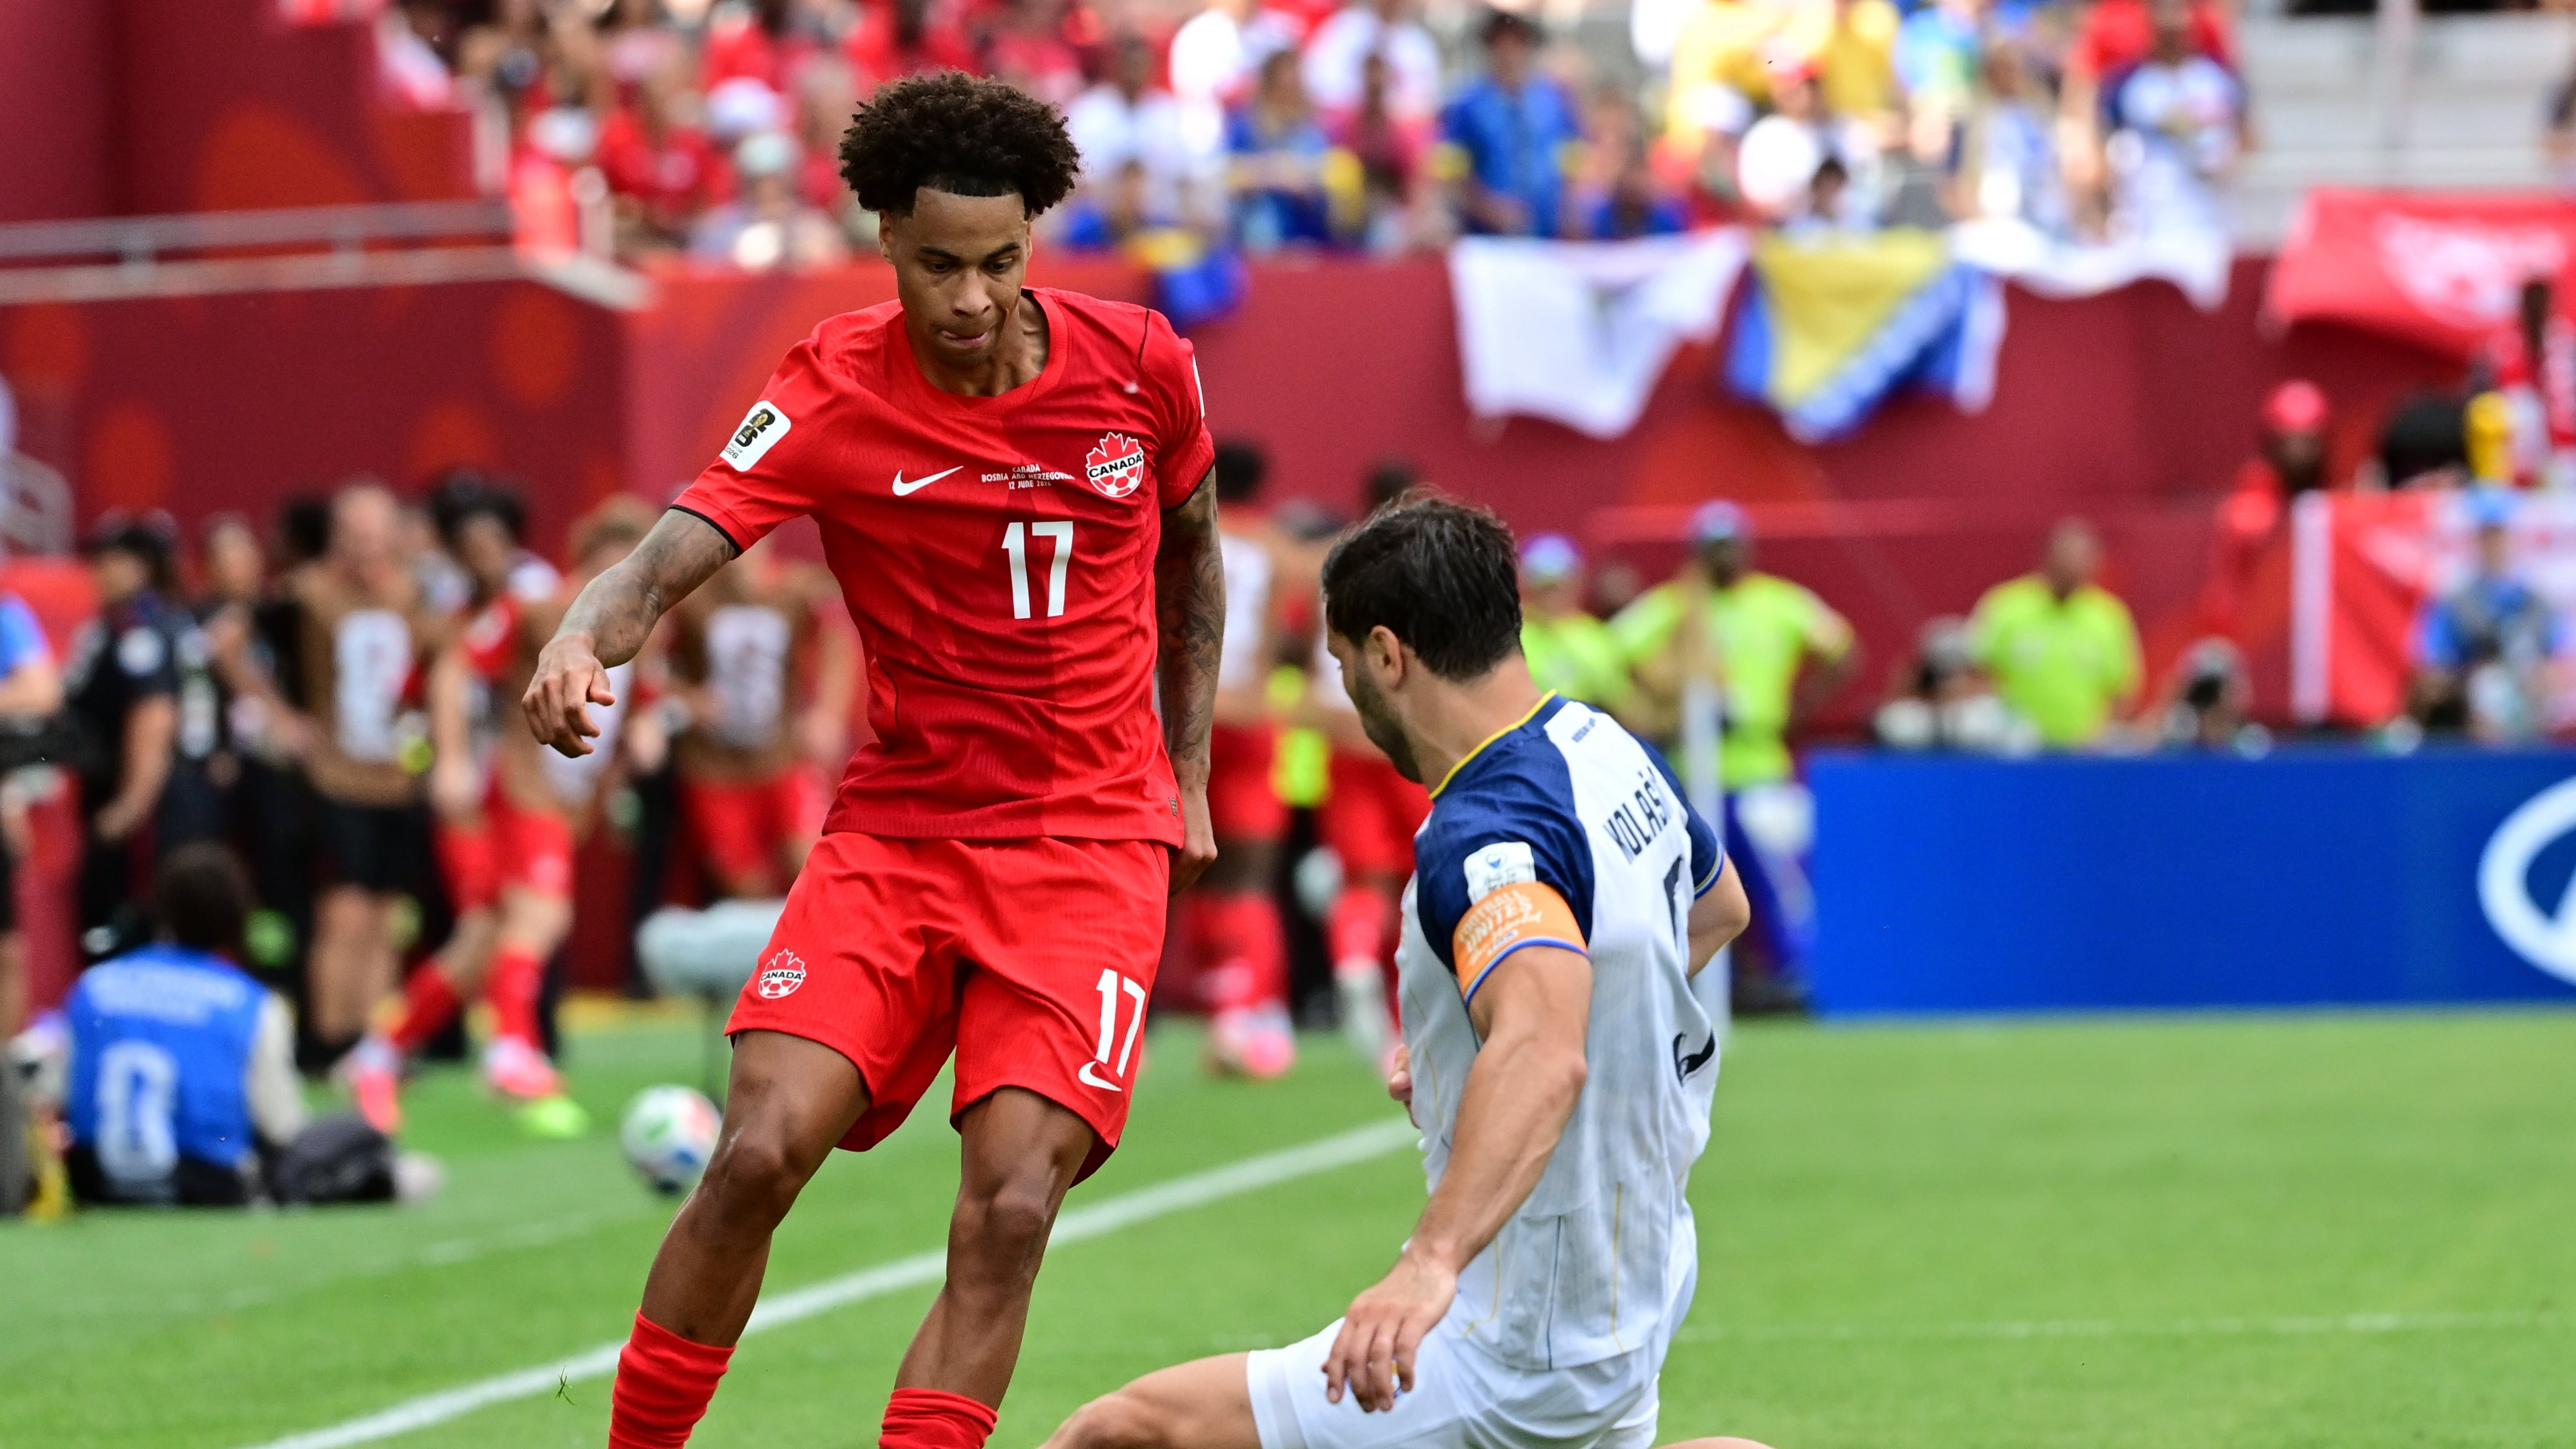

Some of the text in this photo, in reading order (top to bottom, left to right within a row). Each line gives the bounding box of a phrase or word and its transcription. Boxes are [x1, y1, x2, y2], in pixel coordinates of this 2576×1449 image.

[1012, 463, 1041, 473] CANADA
[1089, 454, 1142, 478] CANADA
[981, 473, 1009, 483] BOSNIA
[1009, 481, 1015, 490] 12
[1018, 480, 1034, 488] JUNE
[1001, 521, 1073, 619] 17
[1603, 766, 1668, 865] KOLAŠ
[761, 971, 802, 982] CANADA
[1095, 968, 1146, 1079] 17
